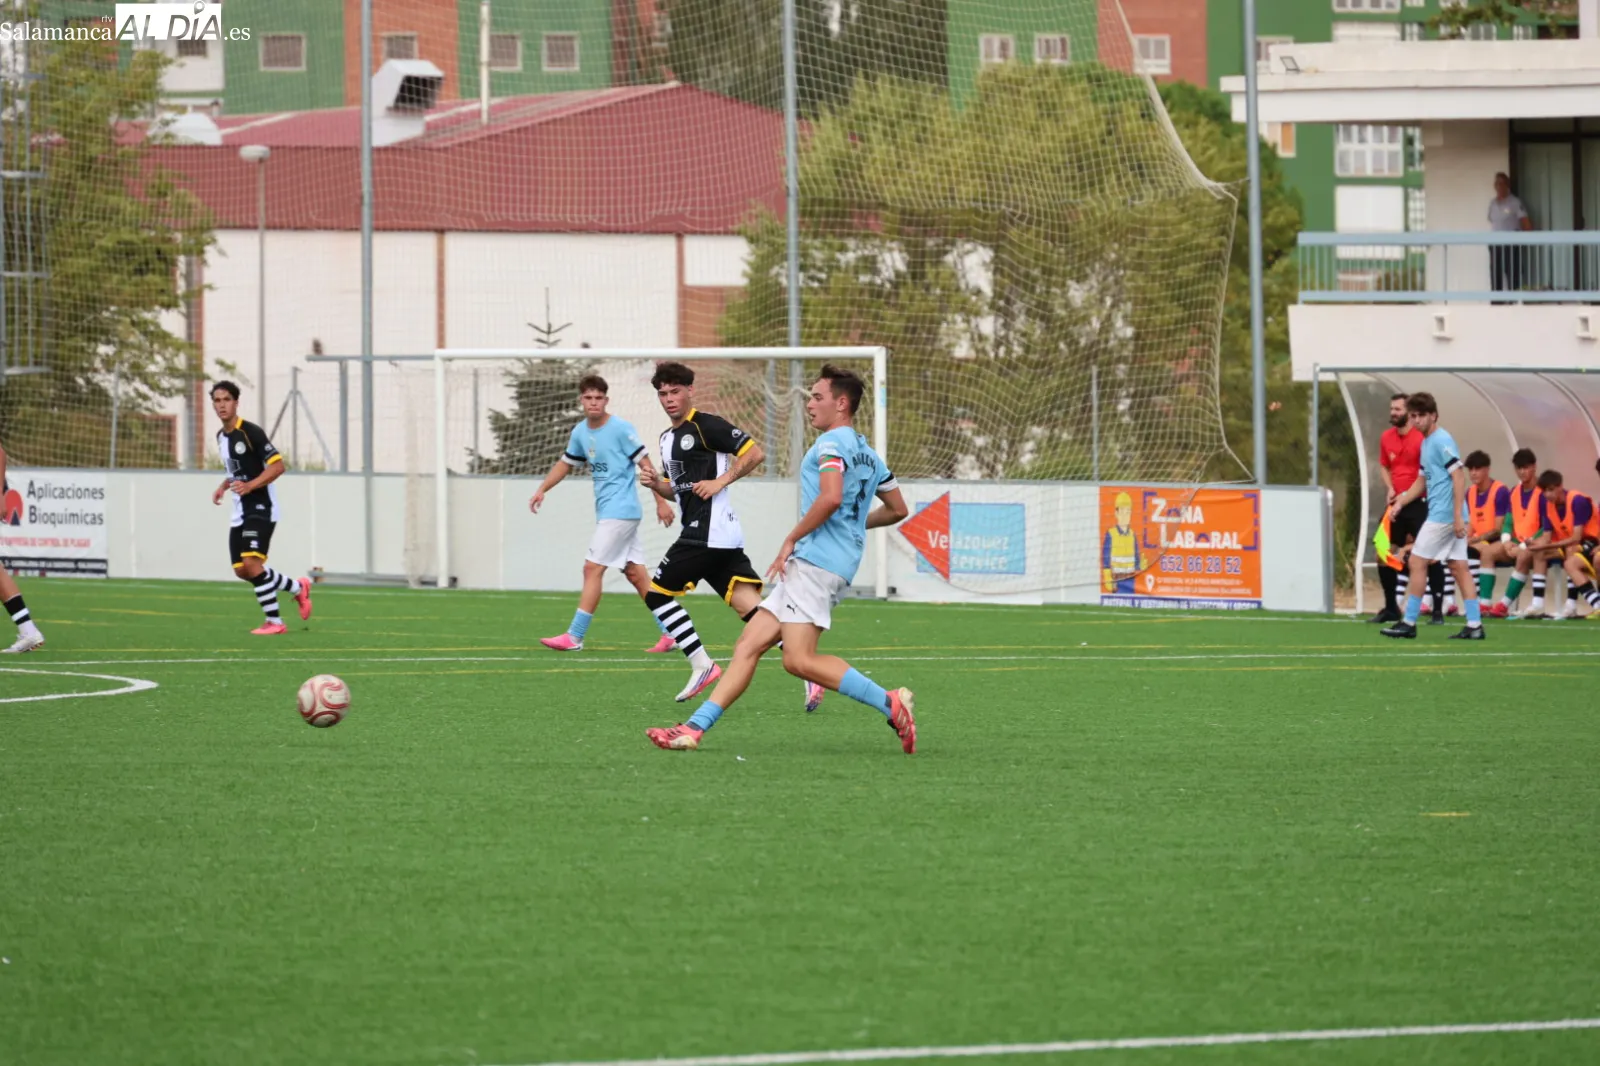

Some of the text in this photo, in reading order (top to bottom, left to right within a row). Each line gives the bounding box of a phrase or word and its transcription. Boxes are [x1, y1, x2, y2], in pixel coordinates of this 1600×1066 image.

[27, 480, 105, 501] Aplicaciones
[1151, 497, 1204, 524] ZONA
[1160, 522, 1242, 550] LABORAL
[1160, 555, 1242, 574] 652 86 28 52
